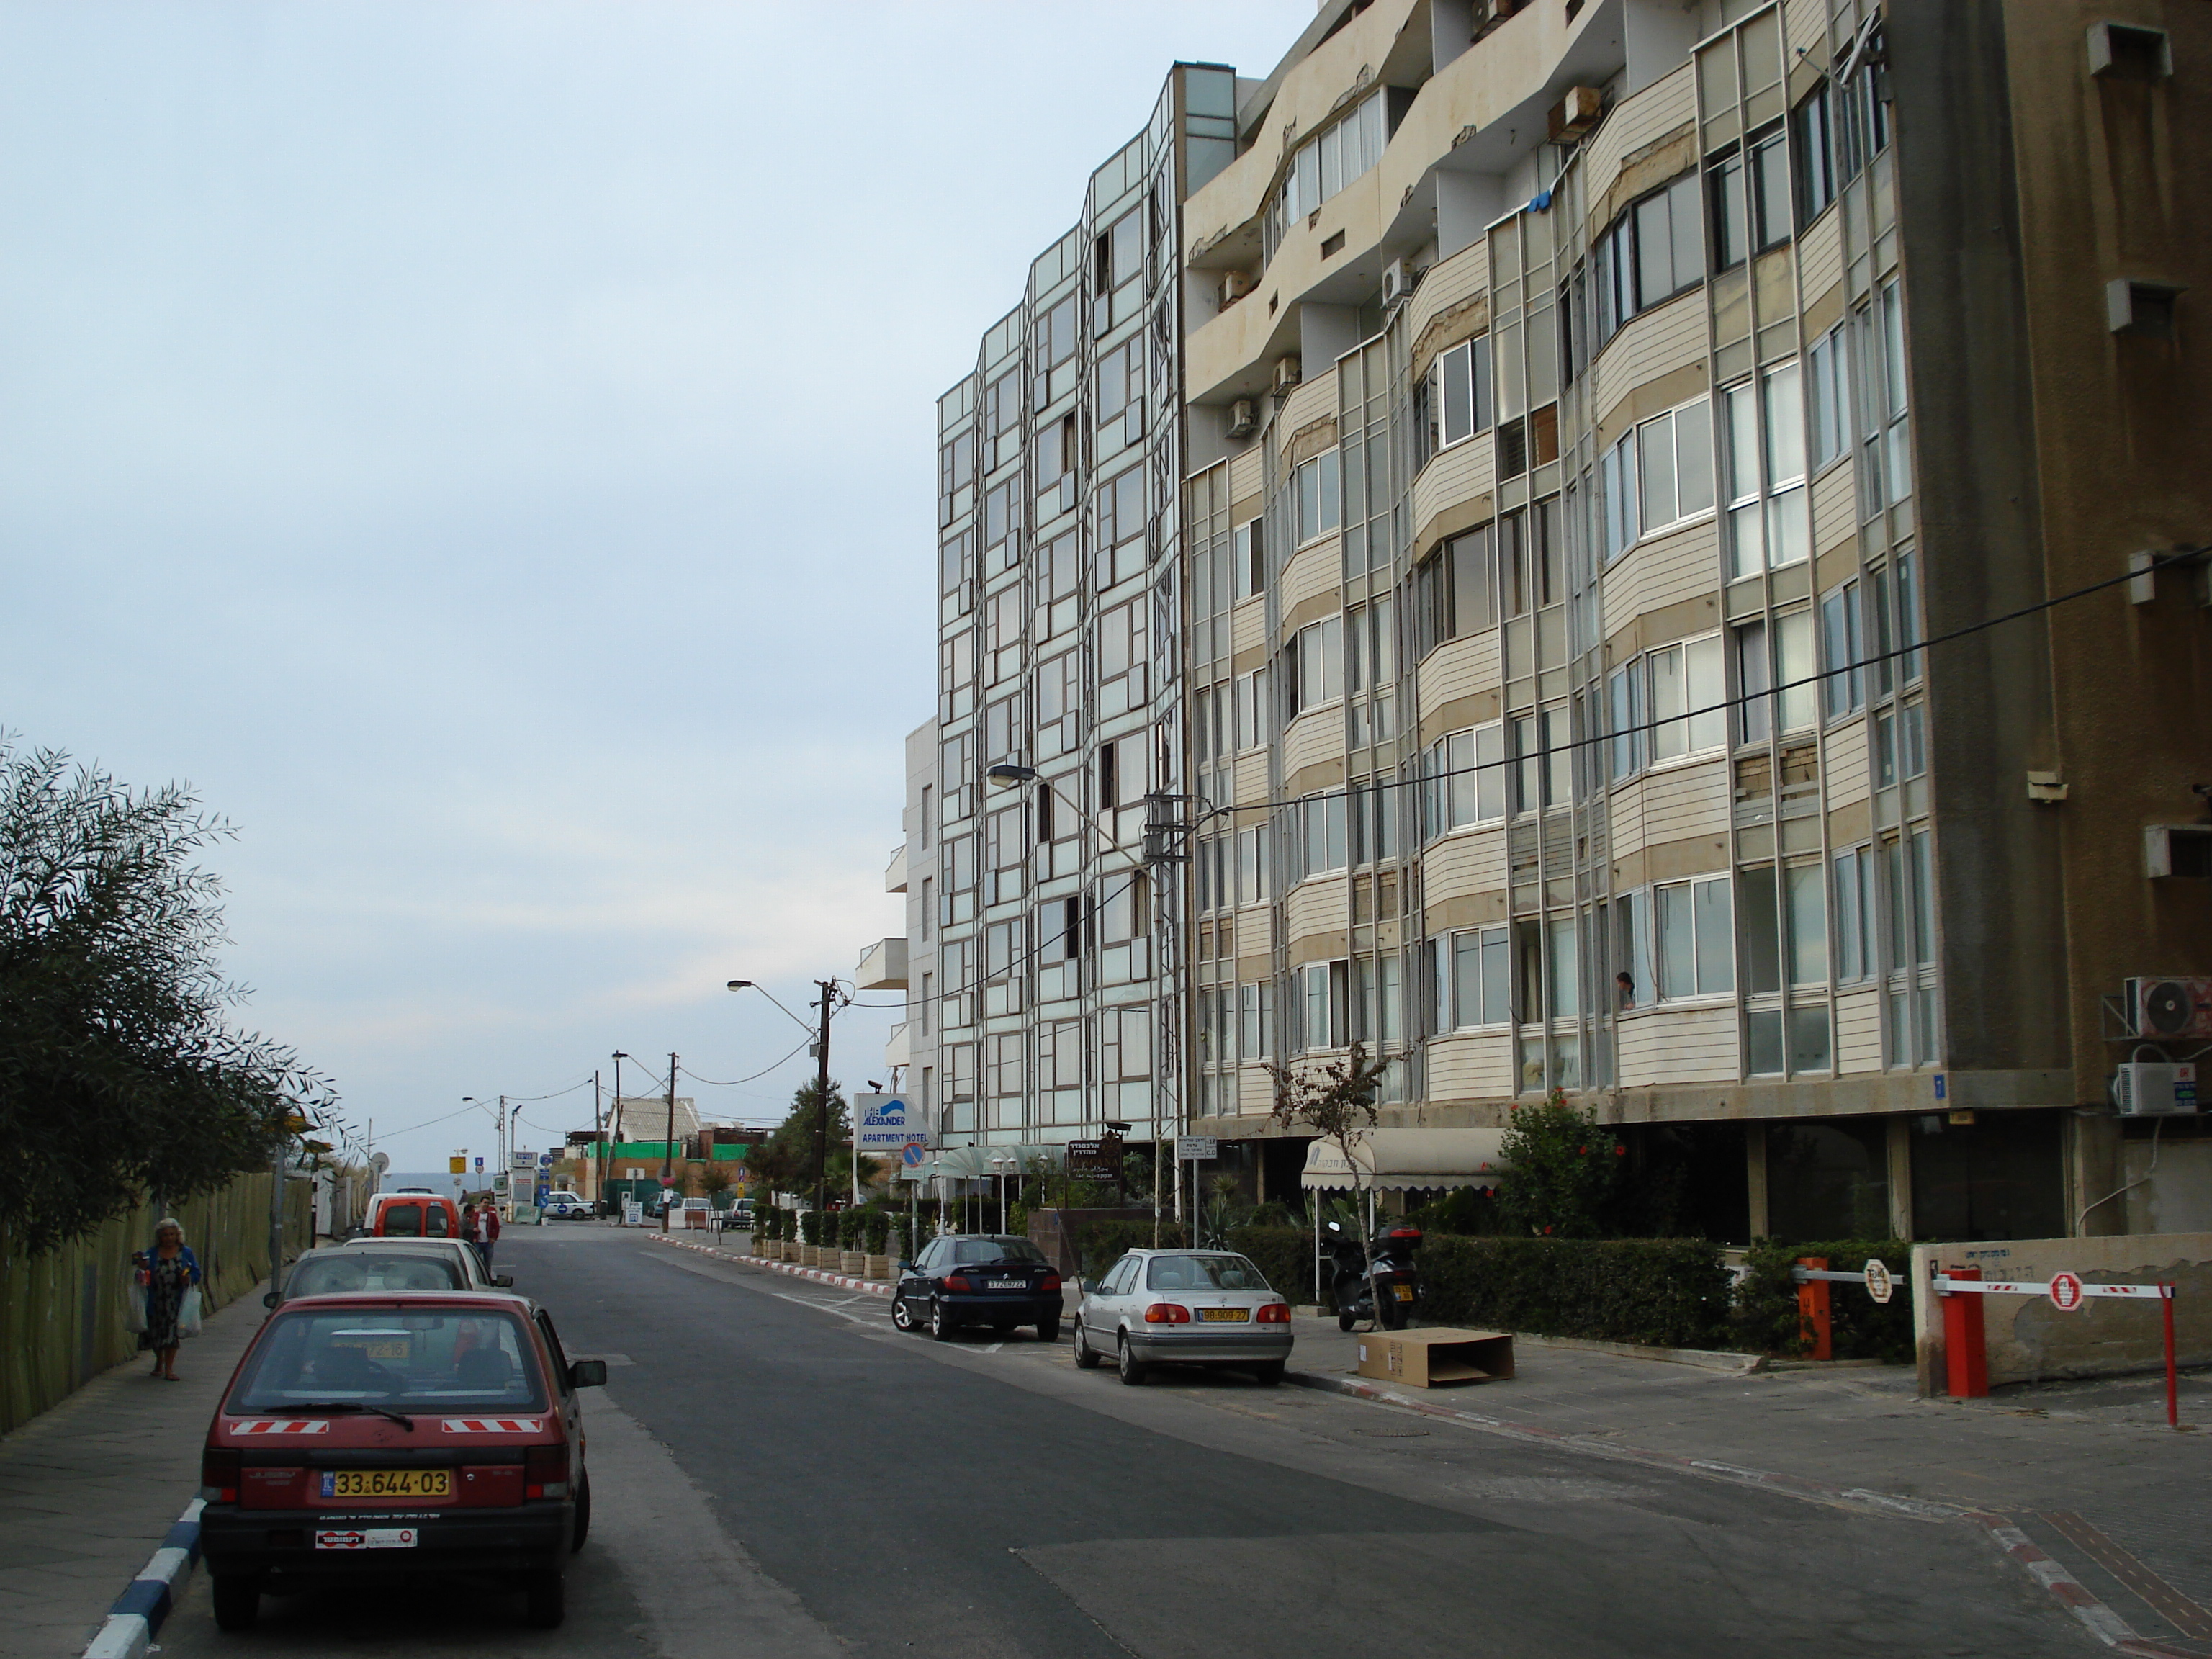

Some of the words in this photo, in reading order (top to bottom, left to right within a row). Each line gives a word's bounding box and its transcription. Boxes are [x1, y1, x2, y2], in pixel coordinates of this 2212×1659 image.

[864, 1107, 879, 1117] THE
[863, 1116, 905, 1125] ALEXANDER
[863, 1133, 904, 1142] APARTMENT
[906, 1133, 928, 1142] HOTEL
